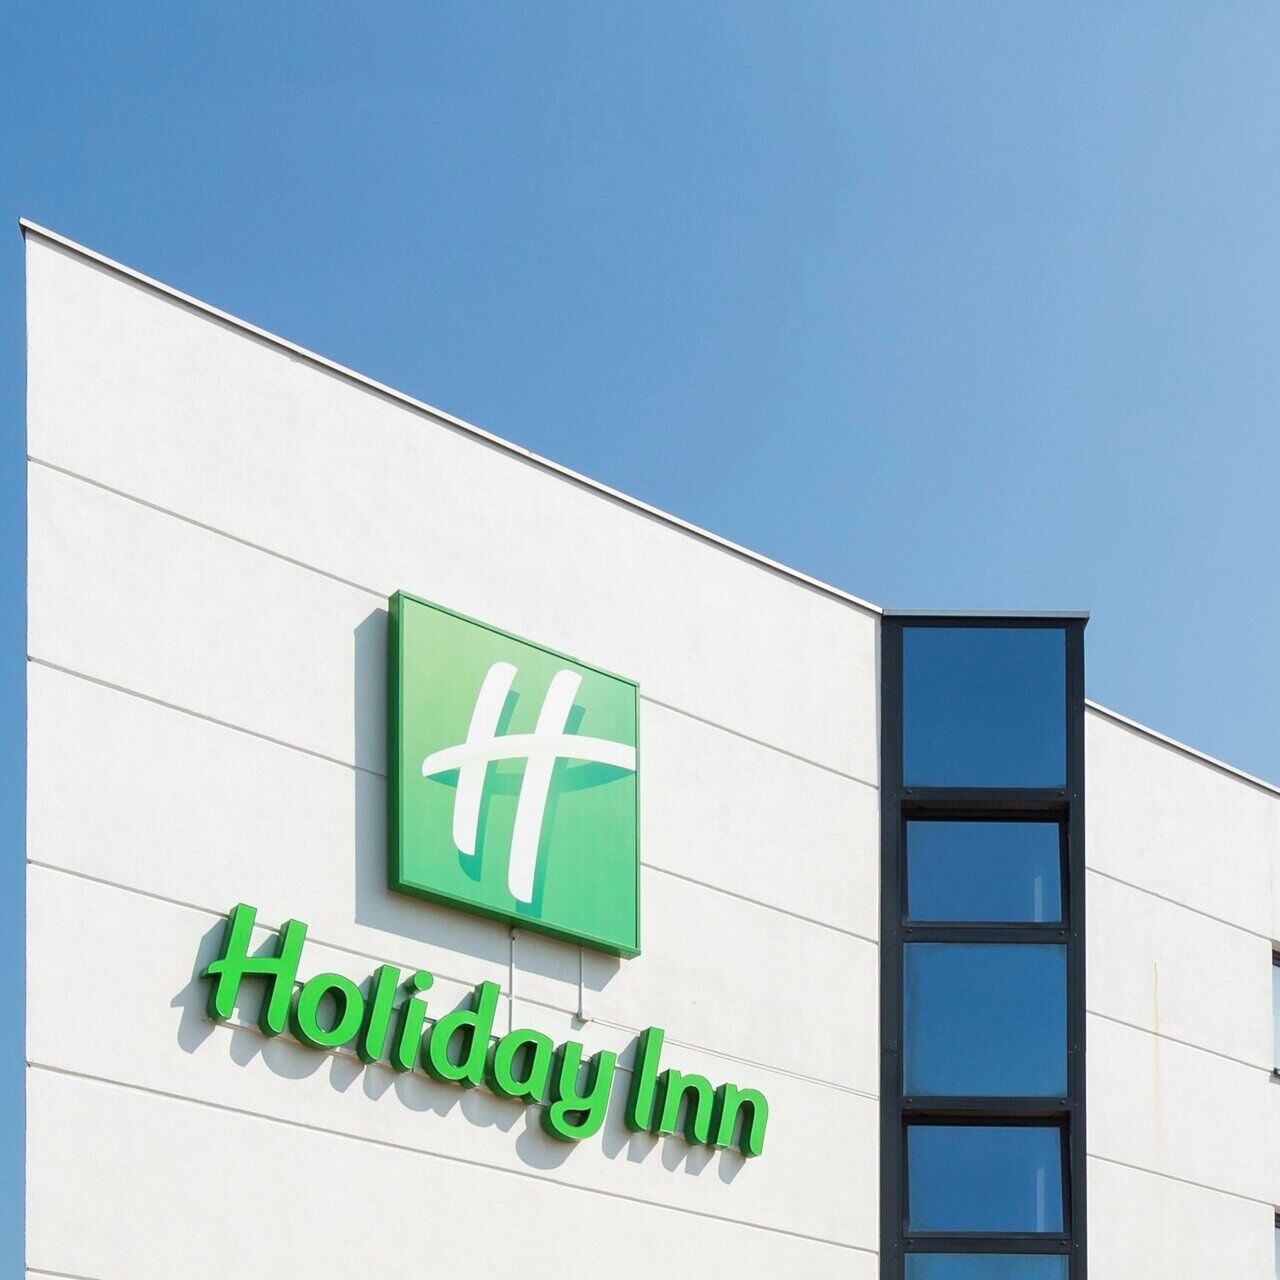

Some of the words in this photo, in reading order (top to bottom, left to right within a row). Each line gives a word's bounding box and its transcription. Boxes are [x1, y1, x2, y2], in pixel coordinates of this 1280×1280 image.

[422, 662, 636, 903] H
[202, 902, 617, 1141] Holiday
[626, 1026, 769, 1158] Inn
